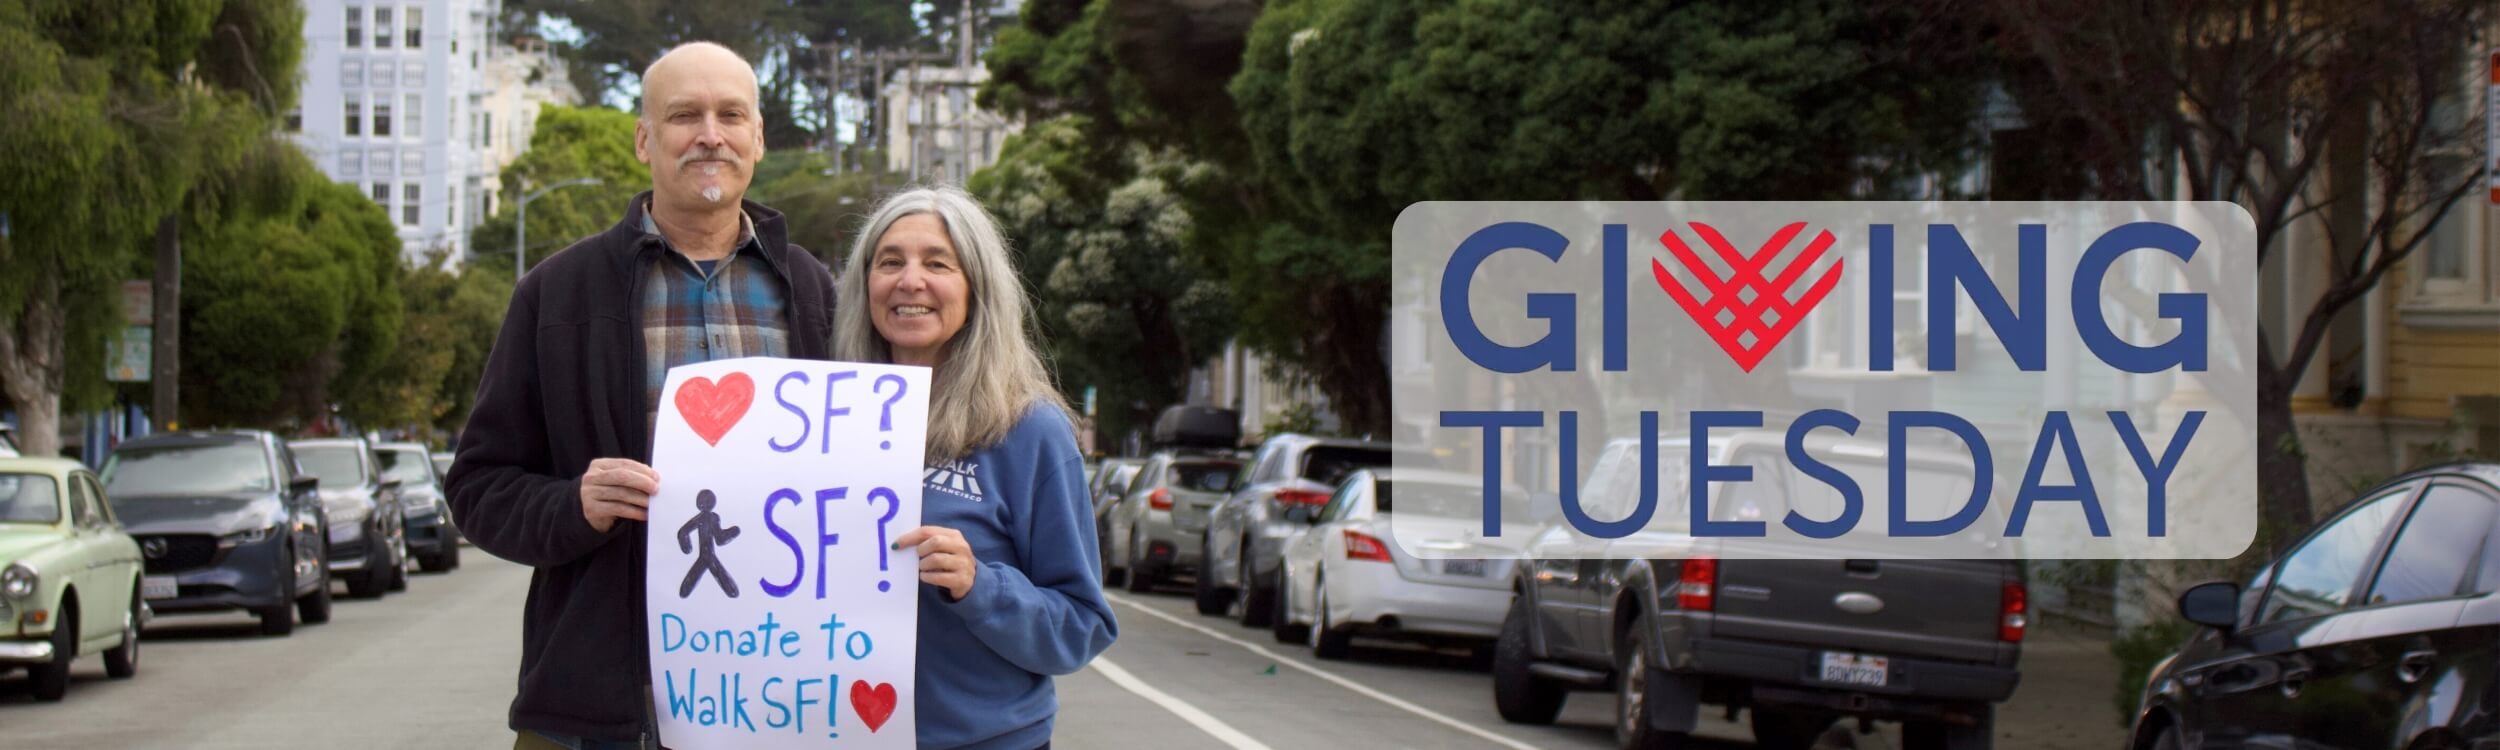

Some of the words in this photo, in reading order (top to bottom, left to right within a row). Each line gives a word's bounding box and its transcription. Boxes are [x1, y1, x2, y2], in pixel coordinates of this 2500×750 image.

[768, 371, 907, 454] SF?
[930, 484, 982, 502] FRANCISCO
[759, 486, 900, 600] SF?
[661, 611, 801, 657] Donate
[820, 613, 874, 662] to
[664, 667, 756, 733] Walk
[761, 672, 841, 740] SF!
